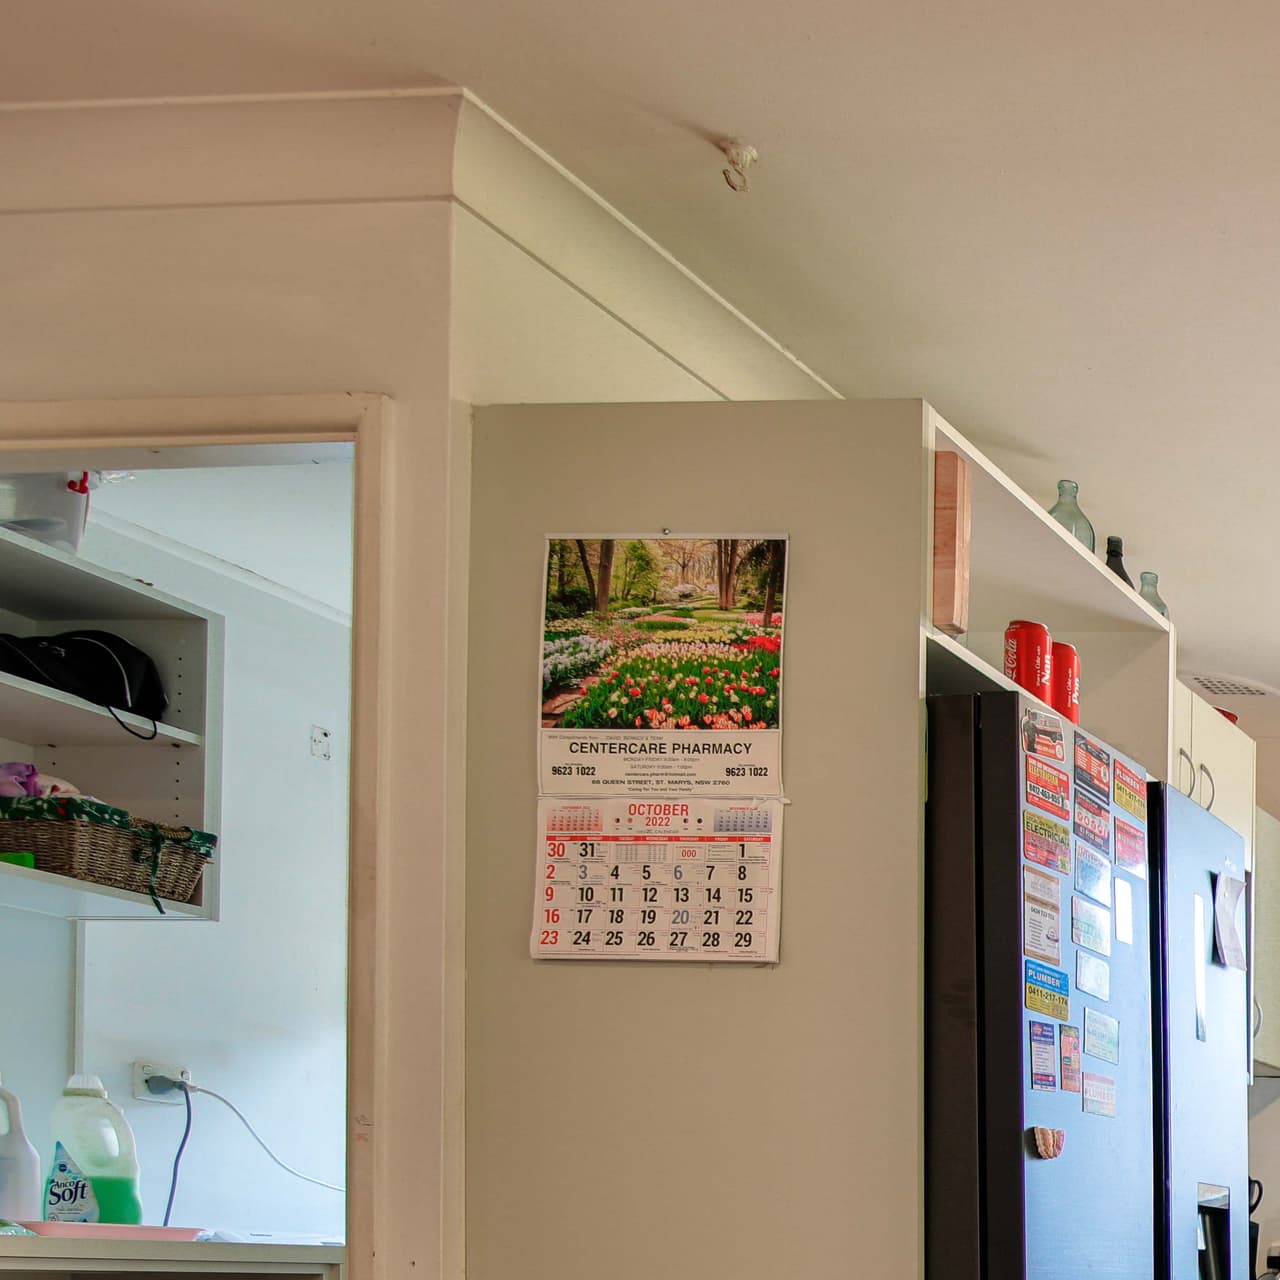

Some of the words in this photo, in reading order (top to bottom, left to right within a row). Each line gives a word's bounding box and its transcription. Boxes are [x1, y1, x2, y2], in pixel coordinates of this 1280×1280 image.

[1041, 654, 1051, 686] Nan
[569, 742, 667, 754] CENTERCARE
[672, 743, 752, 754] PHARMACY
[552, 766, 572, 776] 9623
[576, 766, 596, 776] 1022
[726, 768, 746, 776] 9623
[748, 768, 768, 776] 1022
[1116, 767, 1140, 791] PLUMBER
[628, 804, 689, 816] OCTOBER
[646, 816, 670, 826] 2022
[1026, 821, 1070, 847] ELECTRICIAN
[548, 842, 566, 858] 30
[580, 842, 595, 858] 31
[682, 849, 697, 858] 000
[739, 844, 745, 858] 1
[546, 864, 556, 879] 2
[579, 864, 588, 879] 3
[610, 865, 620, 880] 4
[642, 865, 651, 880] 5
[674, 865, 683, 880] 6
[706, 866, 715, 880] 7
[738, 866, 746, 880] 8
[545, 886, 554, 901] 9
[578, 887, 594, 902] 10
[610, 887, 624, 902] 11
[642, 887, 657, 902] 12
[674, 887, 689, 902] 13
[705, 888, 721, 902] 14
[738, 888, 753, 903] 15
[544, 908, 560, 924] 16
[577, 909, 593, 924] 17
[609, 909, 624, 924] 18
[641, 910, 656, 924] 19
[672, 910, 689, 924] 20
[704, 910, 719, 925] 21
[736, 910, 753, 925] 22
[540, 930, 558, 945] 23
[573, 931, 591, 945] 24
[605, 931, 623, 945] 25
[637, 932, 655, 946] 26
[670, 932, 688, 946] 27
[702, 932, 720, 947] 28
[734, 932, 752, 947] 29
[1028, 970, 1061, 987] PLUMBER
[48, 1180, 88, 1206] Soft
